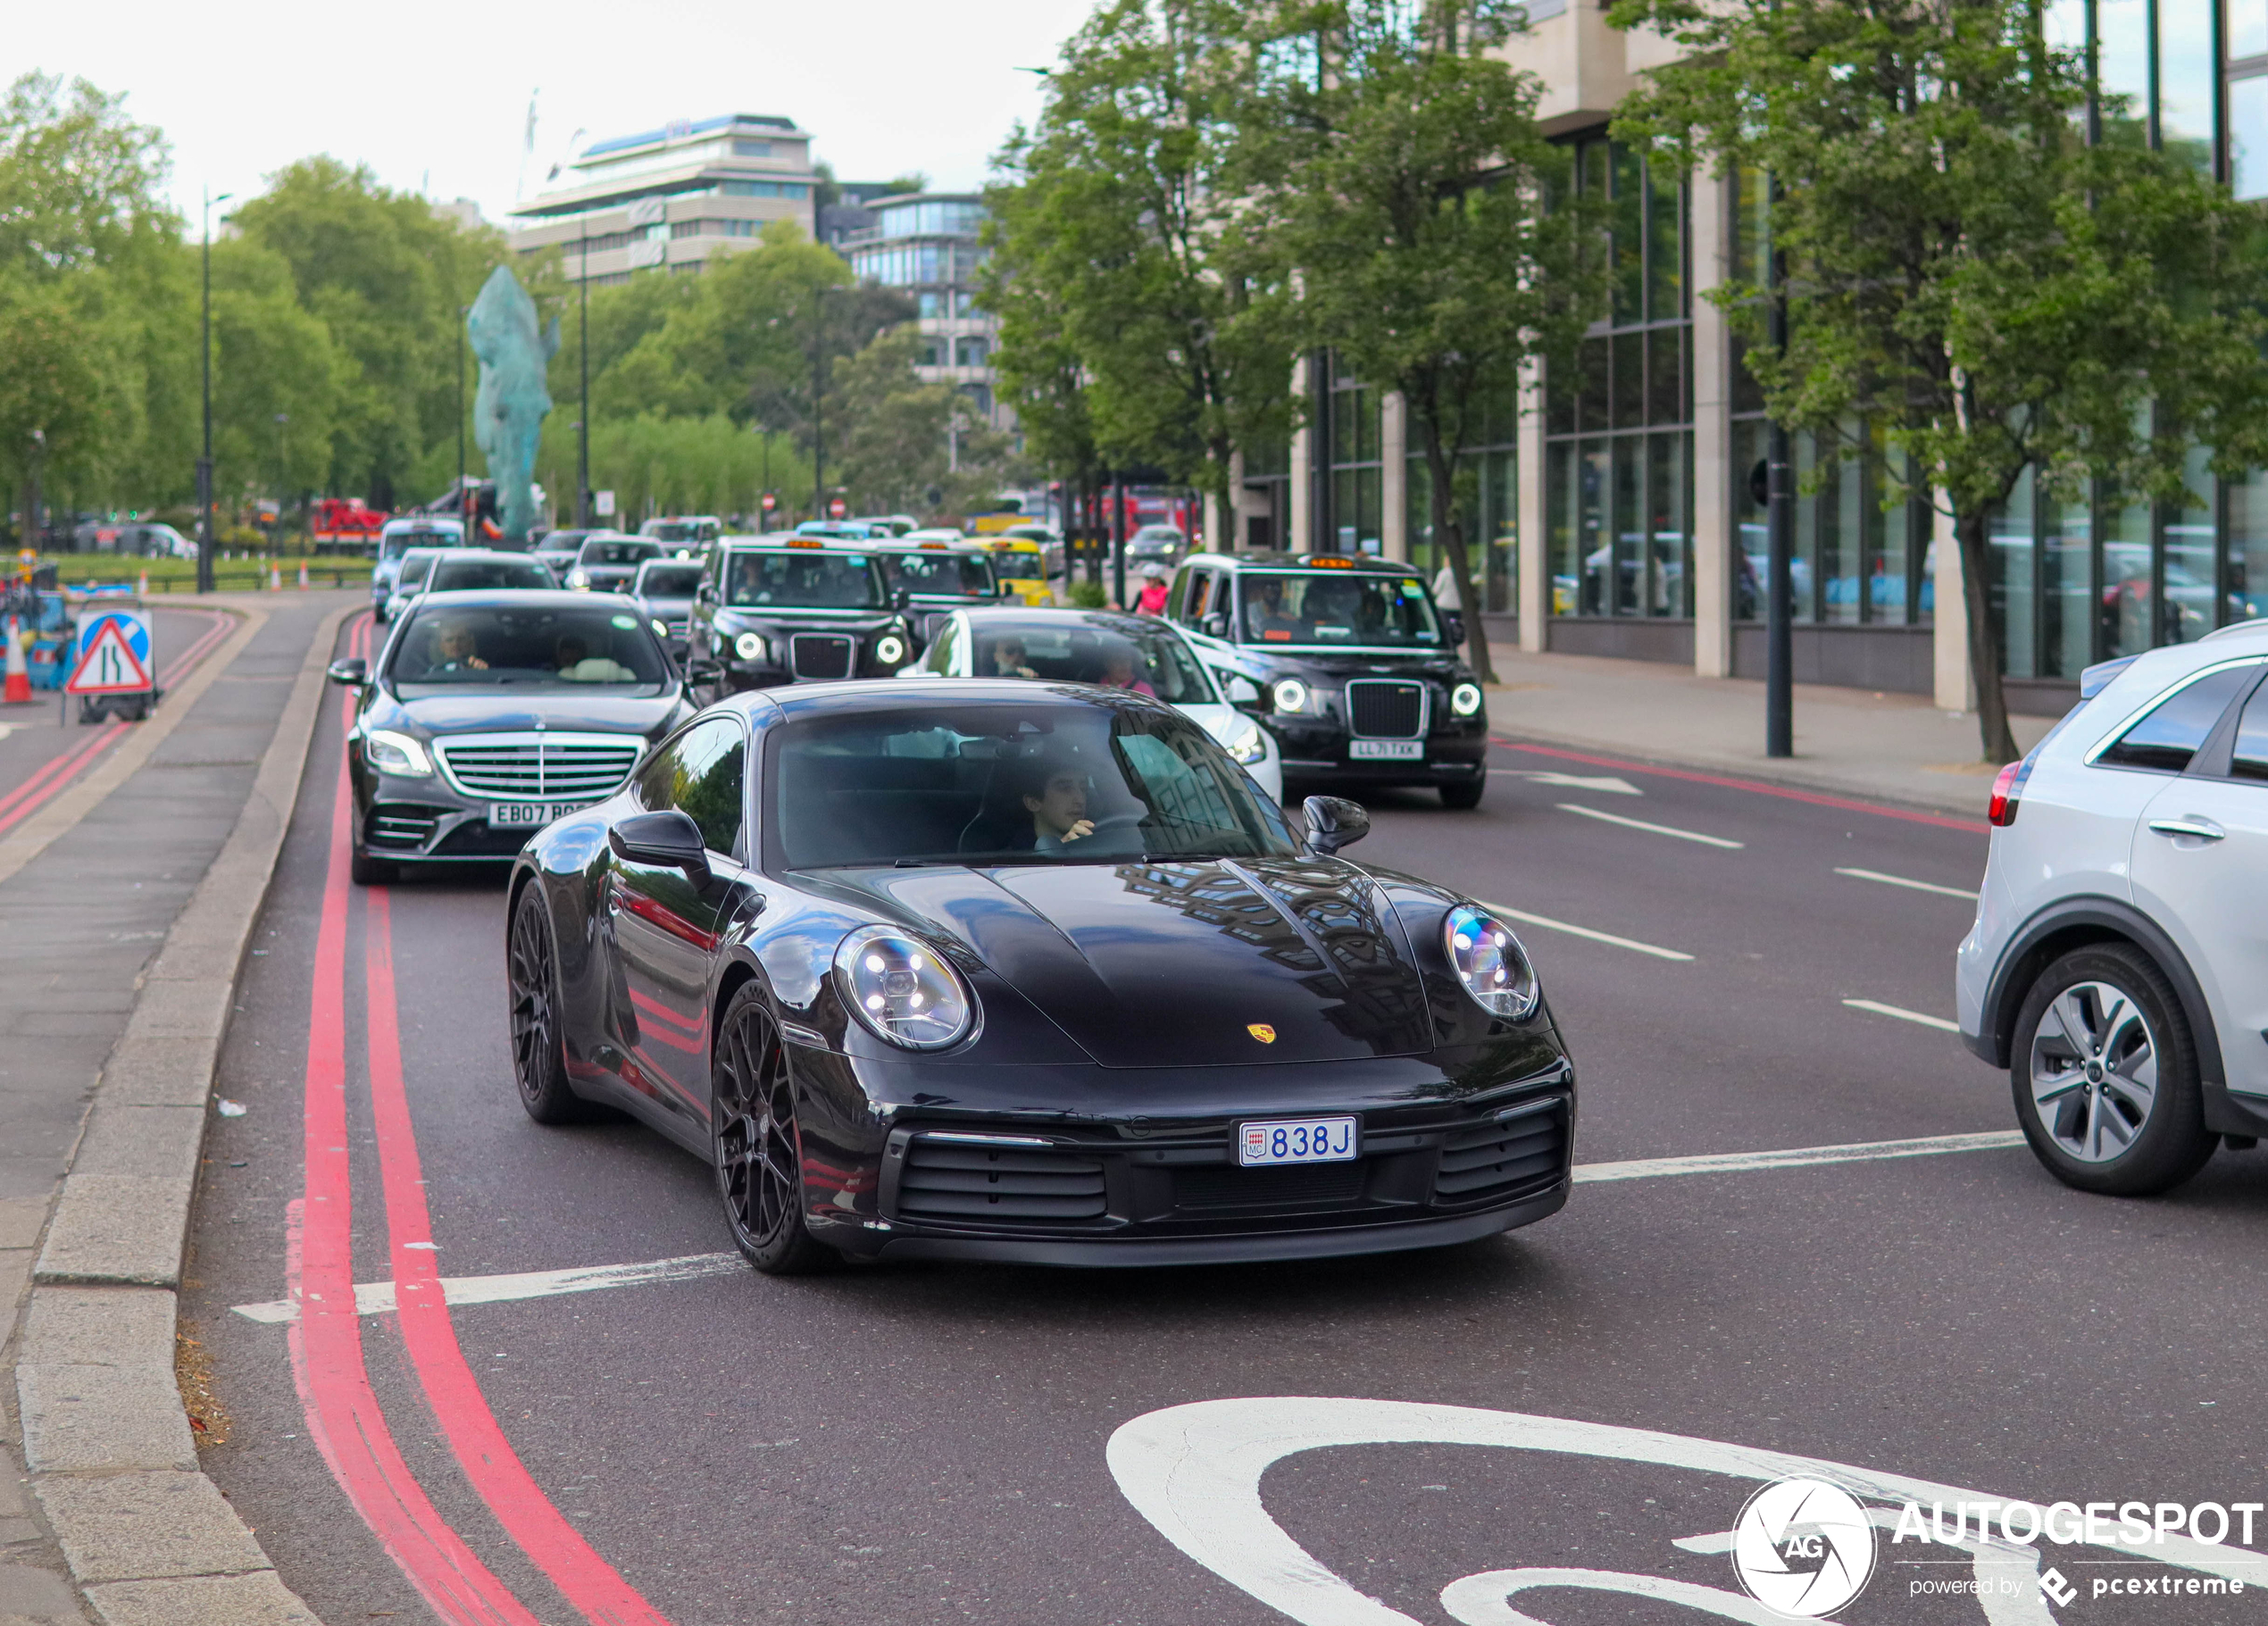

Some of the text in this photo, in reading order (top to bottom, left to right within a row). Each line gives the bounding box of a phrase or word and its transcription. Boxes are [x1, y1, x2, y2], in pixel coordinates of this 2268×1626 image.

[497, 805, 545, 821] EB07
[1272, 1124, 1349, 1158] 838J
[1249, 1145, 1263, 1154] MC
